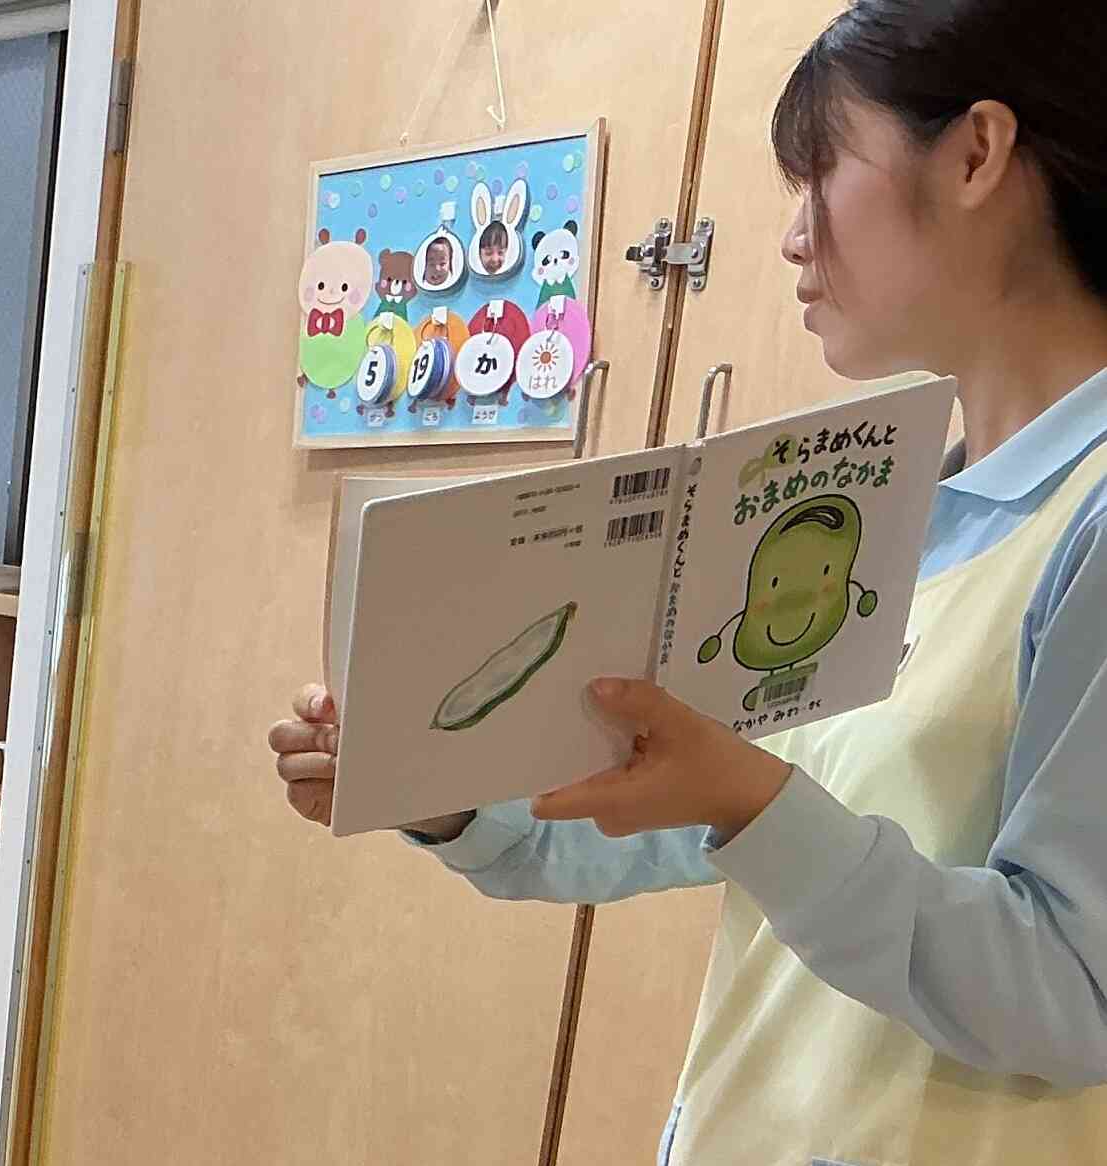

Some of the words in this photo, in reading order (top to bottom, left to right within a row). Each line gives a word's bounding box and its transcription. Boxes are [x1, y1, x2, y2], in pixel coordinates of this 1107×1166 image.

[364, 360, 378, 387] 5
[411, 354, 430, 384] 19
[474, 352, 498, 375] か
[528, 375, 558, 391] はれ
[772, 421, 898, 464] そらまめくんと
[733, 456, 895, 525] おまめのなかま
